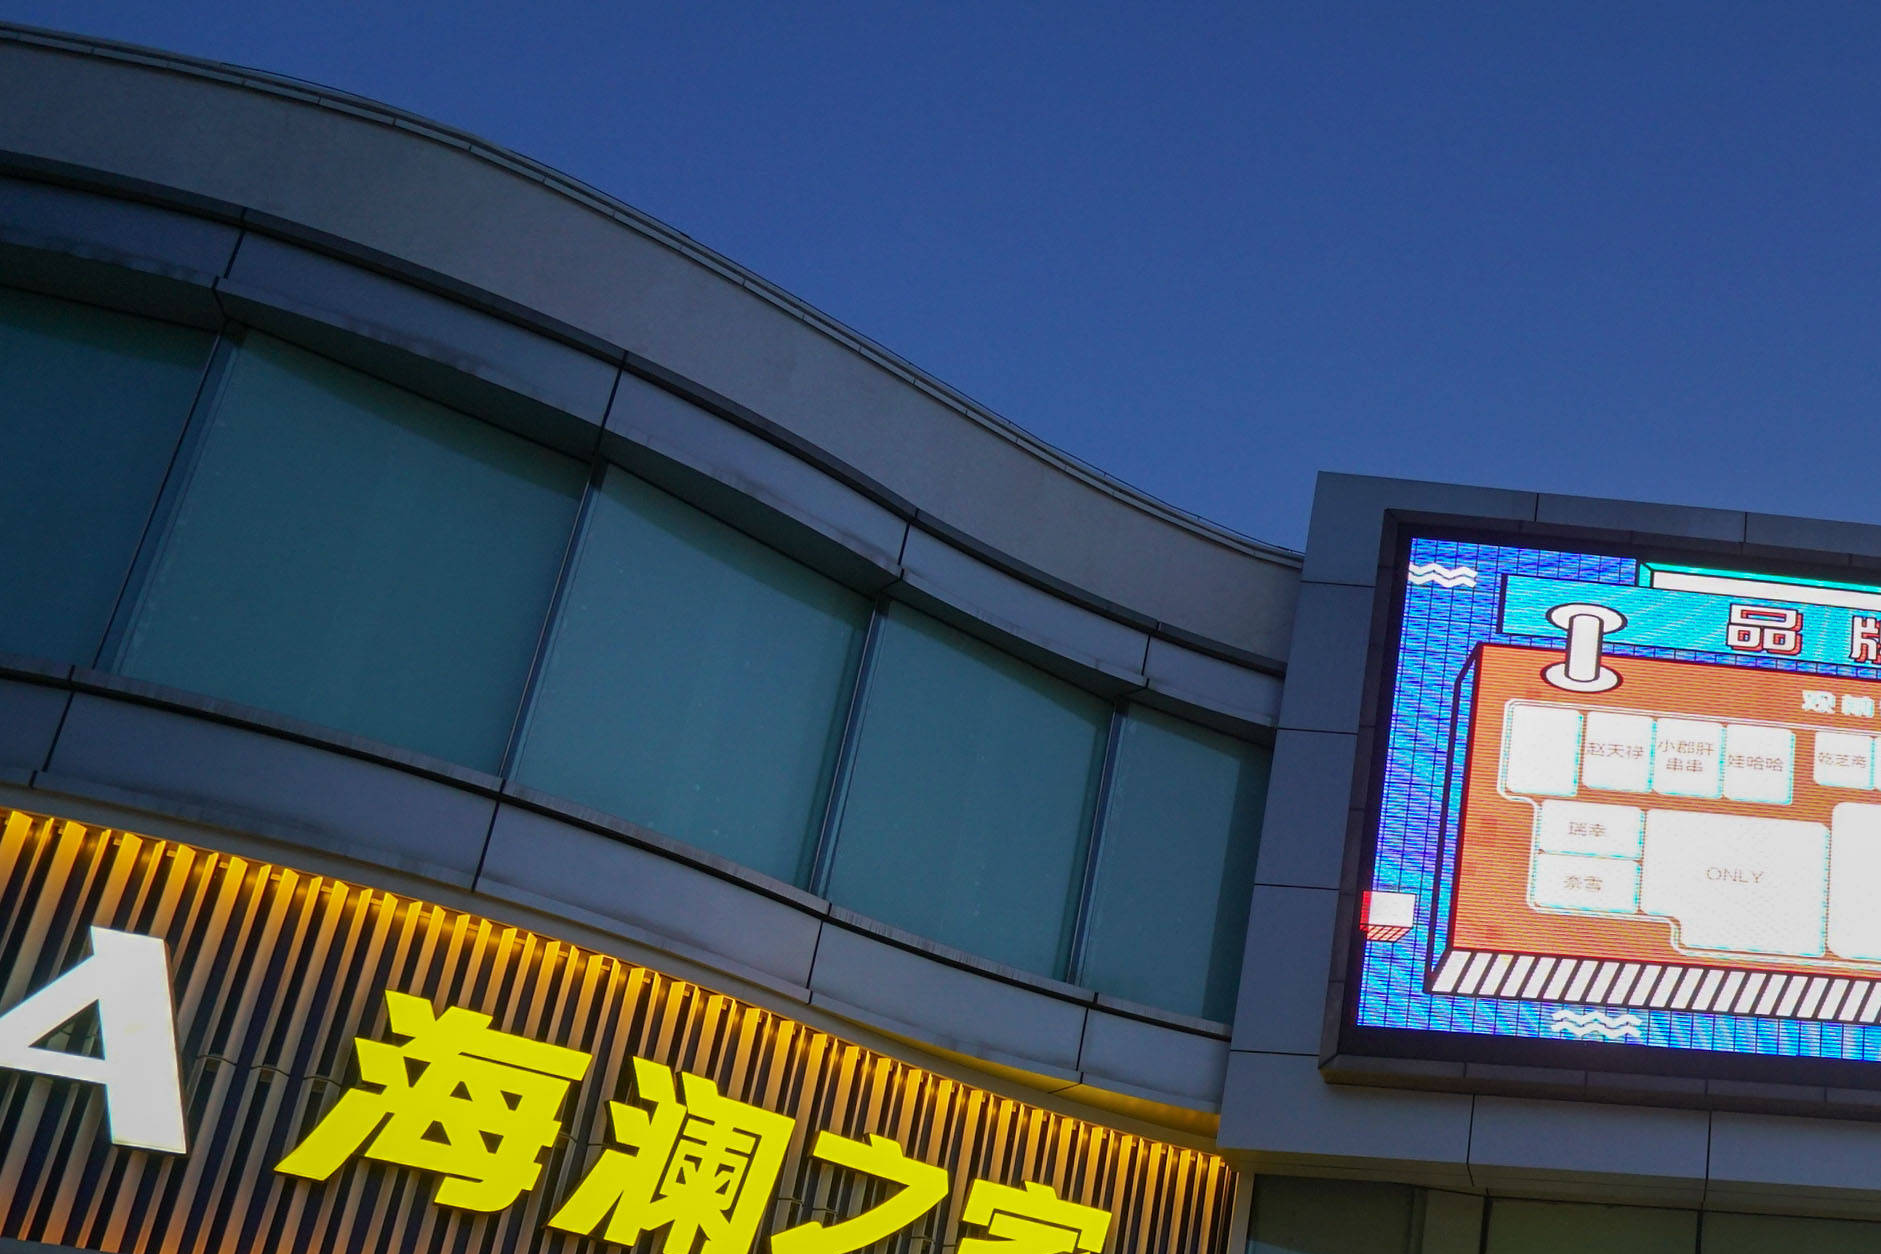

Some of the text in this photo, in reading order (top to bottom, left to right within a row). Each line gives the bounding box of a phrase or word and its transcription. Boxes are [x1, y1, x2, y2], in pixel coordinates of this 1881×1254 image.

[1665, 757, 1704, 773] 串串
[1728, 753, 1784, 772] 娃哈哈
[1568, 820, 1607, 838] 瑞幸
[1705, 866, 1765, 884] ONLY
[0, 926, 187, 1154] A
